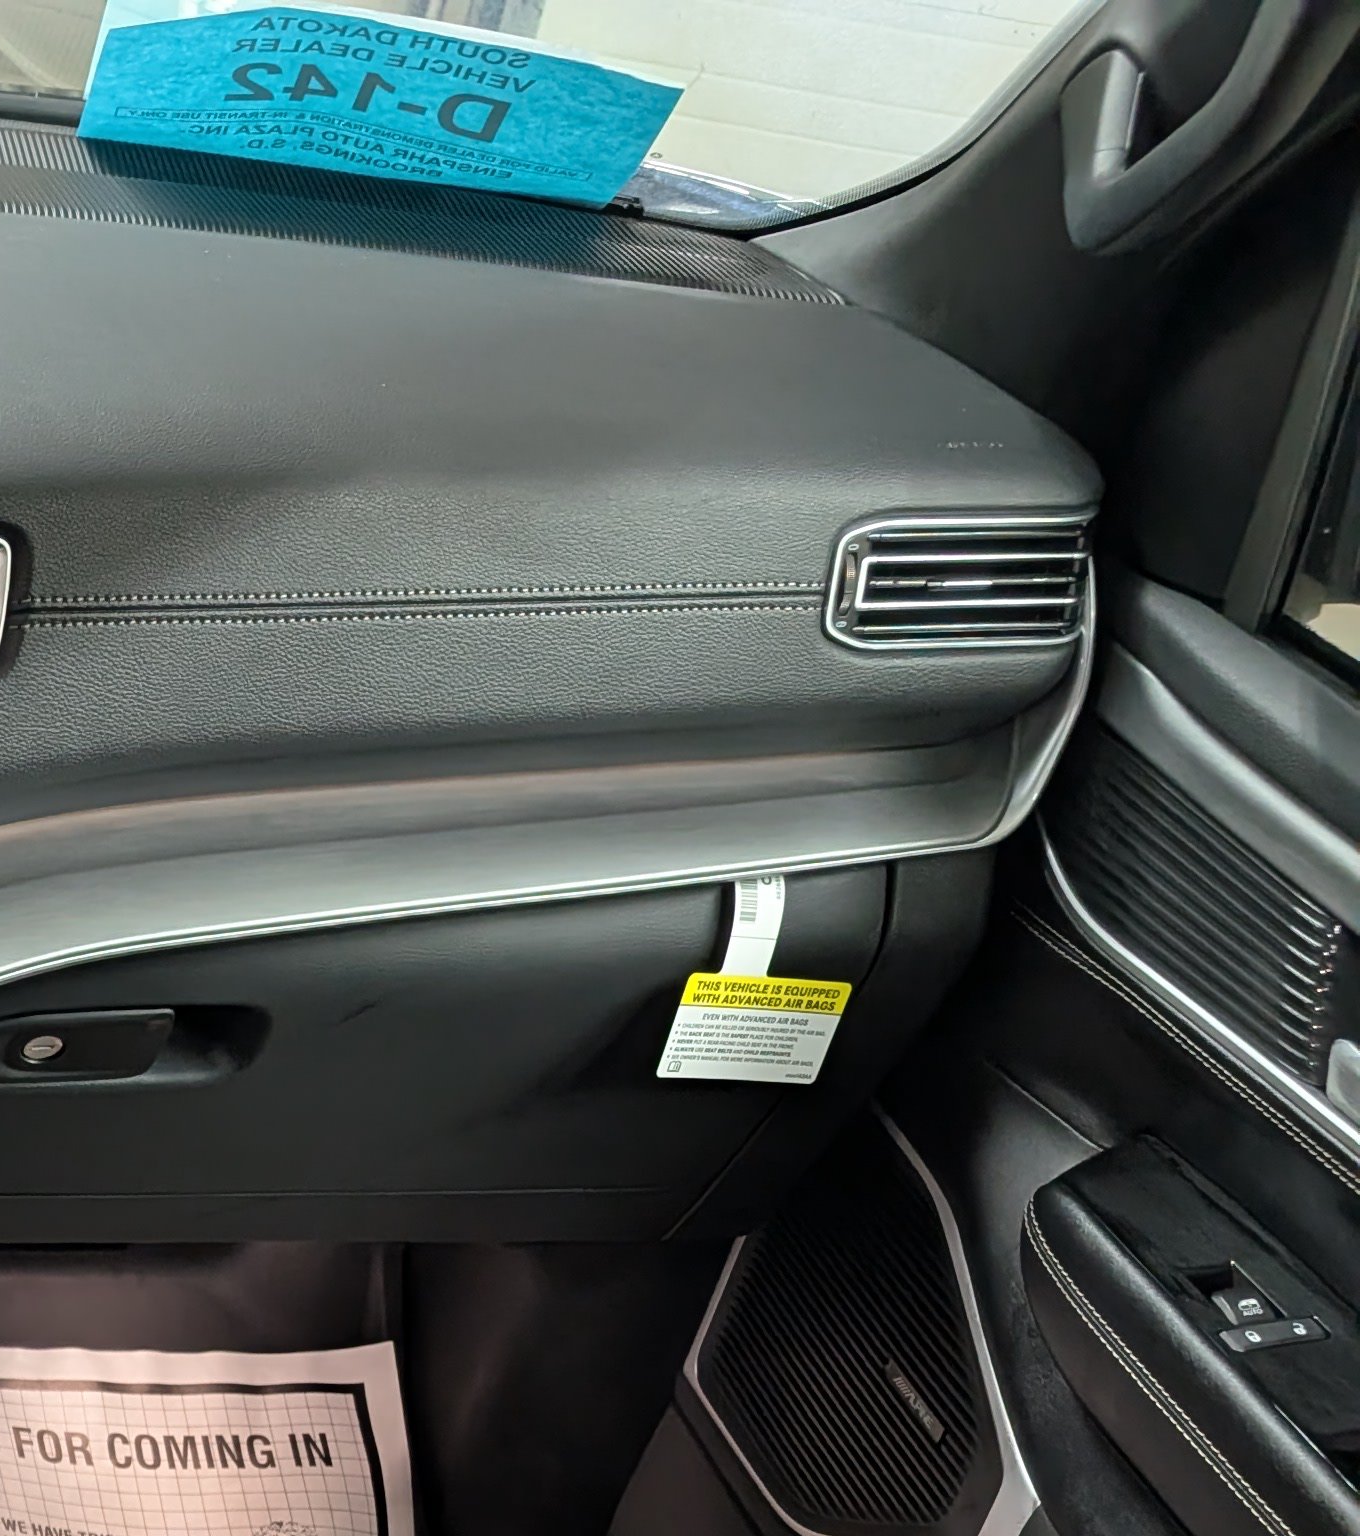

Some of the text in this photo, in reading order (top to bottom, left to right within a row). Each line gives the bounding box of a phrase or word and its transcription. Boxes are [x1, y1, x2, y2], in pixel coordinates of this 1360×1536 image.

[697, 980, 840, 999] THIS VEHICLE IS EQUIPPED
[692, 993, 836, 1012] WITH ADVANCED AIR BAGS
[702, 1013, 720, 1021] EVEN
[721, 1013, 739, 1022] WITH
[740, 1015, 776, 1024] ADVANCED
[790, 1018, 809, 1026] BAGS
[12, 1426, 94, 1467] FOR
[106, 1432, 276, 1470] COMING
[288, 1432, 333, 1468] IN
[1, 1517, 27, 1534] WE
